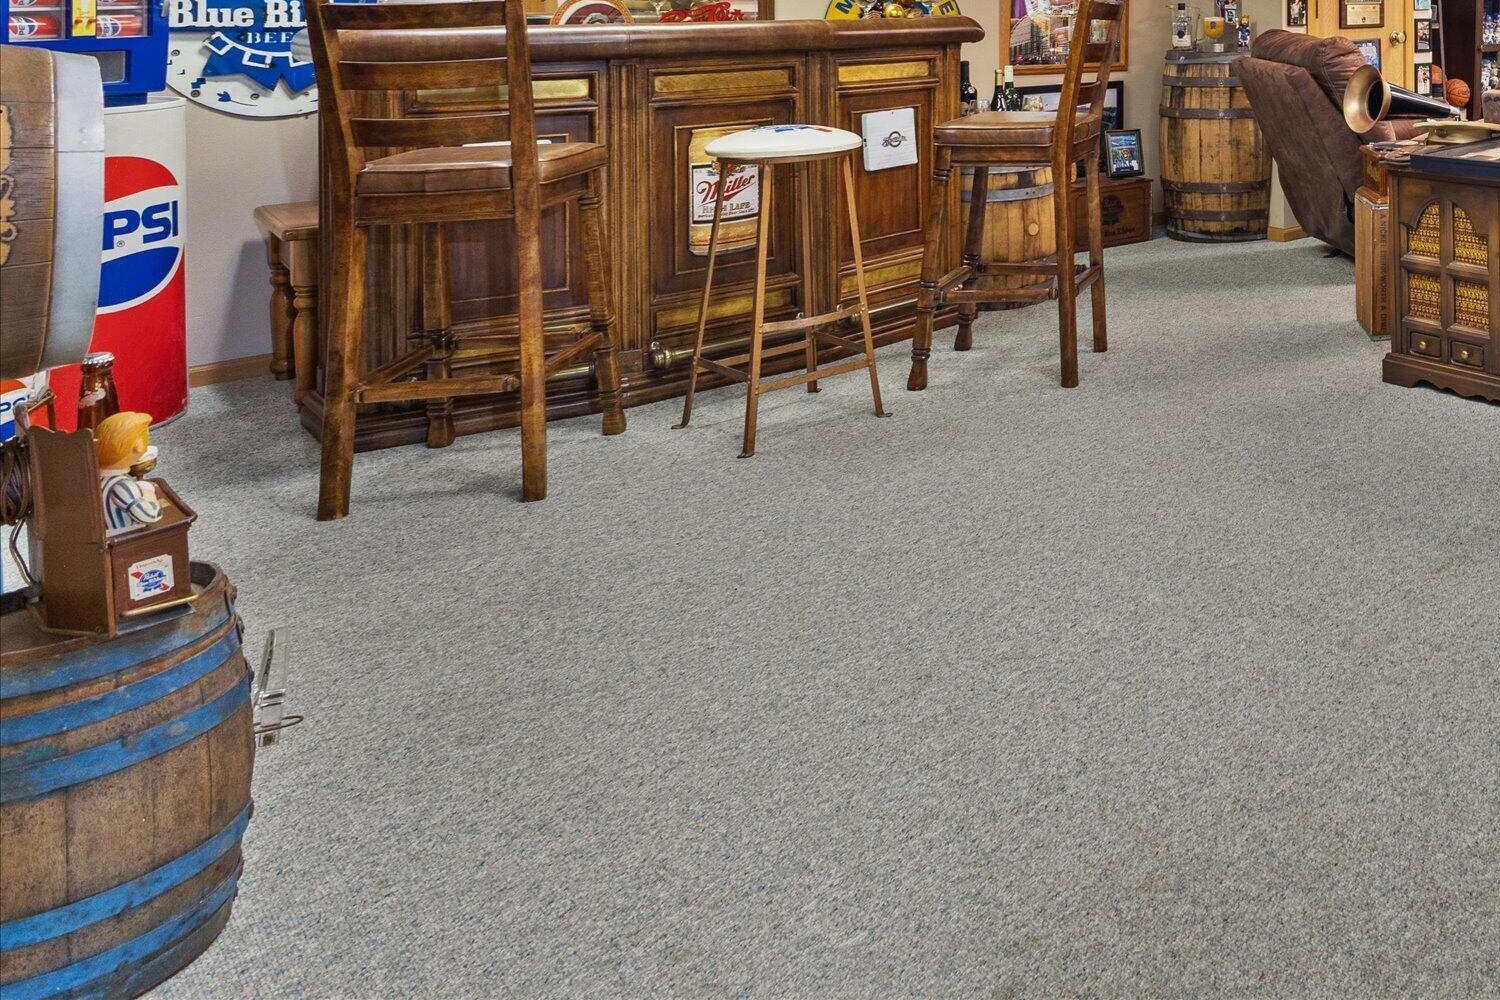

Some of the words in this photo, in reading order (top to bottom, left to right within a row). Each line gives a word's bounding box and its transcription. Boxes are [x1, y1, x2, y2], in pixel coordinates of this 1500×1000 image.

[246, 31, 294, 44] BEE
[697, 174, 755, 204] Miller
[730, 201, 751, 211] LIFE
[102, 200, 178, 251] PSI
